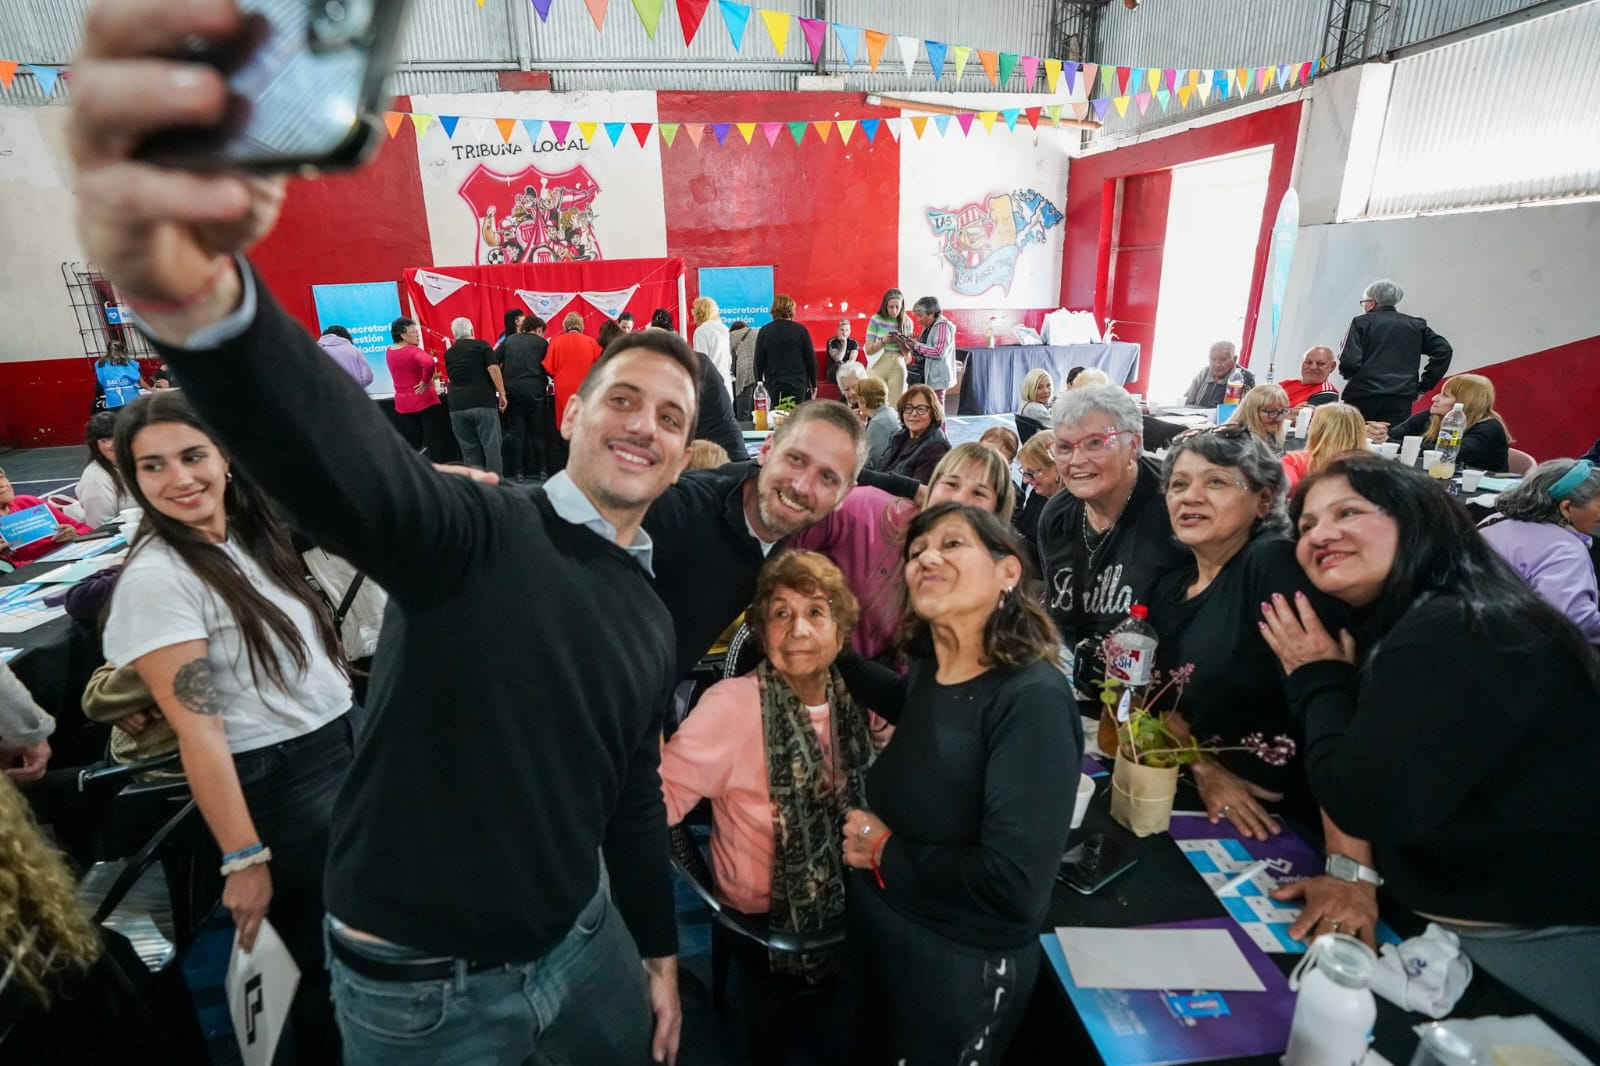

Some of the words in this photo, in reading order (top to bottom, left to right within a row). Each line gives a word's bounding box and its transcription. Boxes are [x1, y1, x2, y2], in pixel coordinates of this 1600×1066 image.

[451, 143, 522, 160] TRIBUNA
[533, 138, 590, 153] LOCAL
[934, 215, 953, 229] LAS
[353, 334, 384, 343] estión
